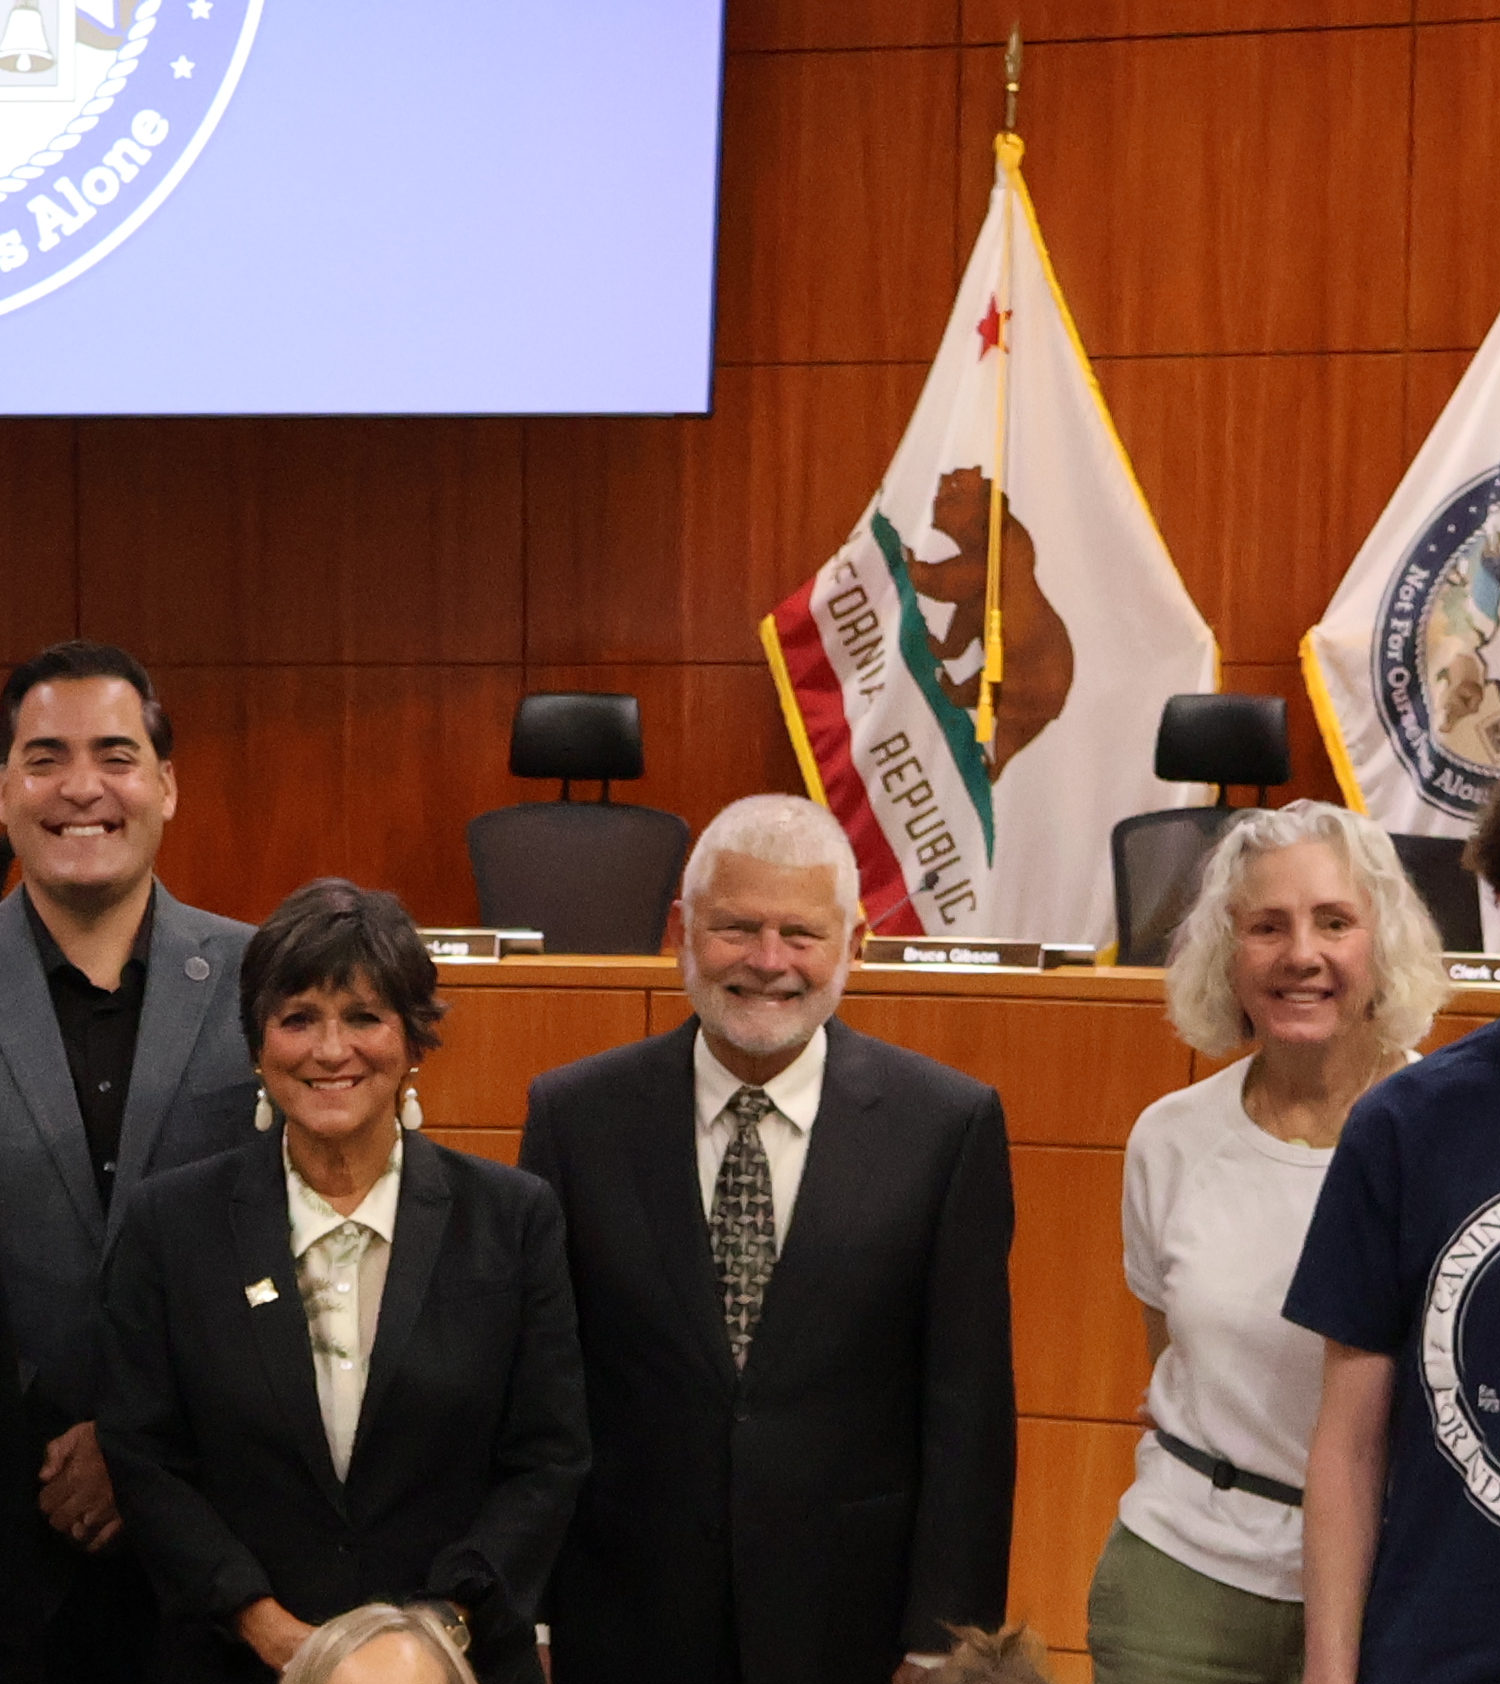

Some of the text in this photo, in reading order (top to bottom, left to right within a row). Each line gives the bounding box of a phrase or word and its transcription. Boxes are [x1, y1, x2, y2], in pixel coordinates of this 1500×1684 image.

[26, 107, 170, 252] Alone
[1398, 563, 1431, 615] Not
[1385, 617, 1414, 662] For
[1432, 768, 1491, 805] Alon
[869, 730, 979, 925] REPUBLIC
[903, 945, 1000, 964] Bruce Gibson
[1449, 963, 1492, 980] Clerk
[1437, 1403, 1469, 1449] OR
